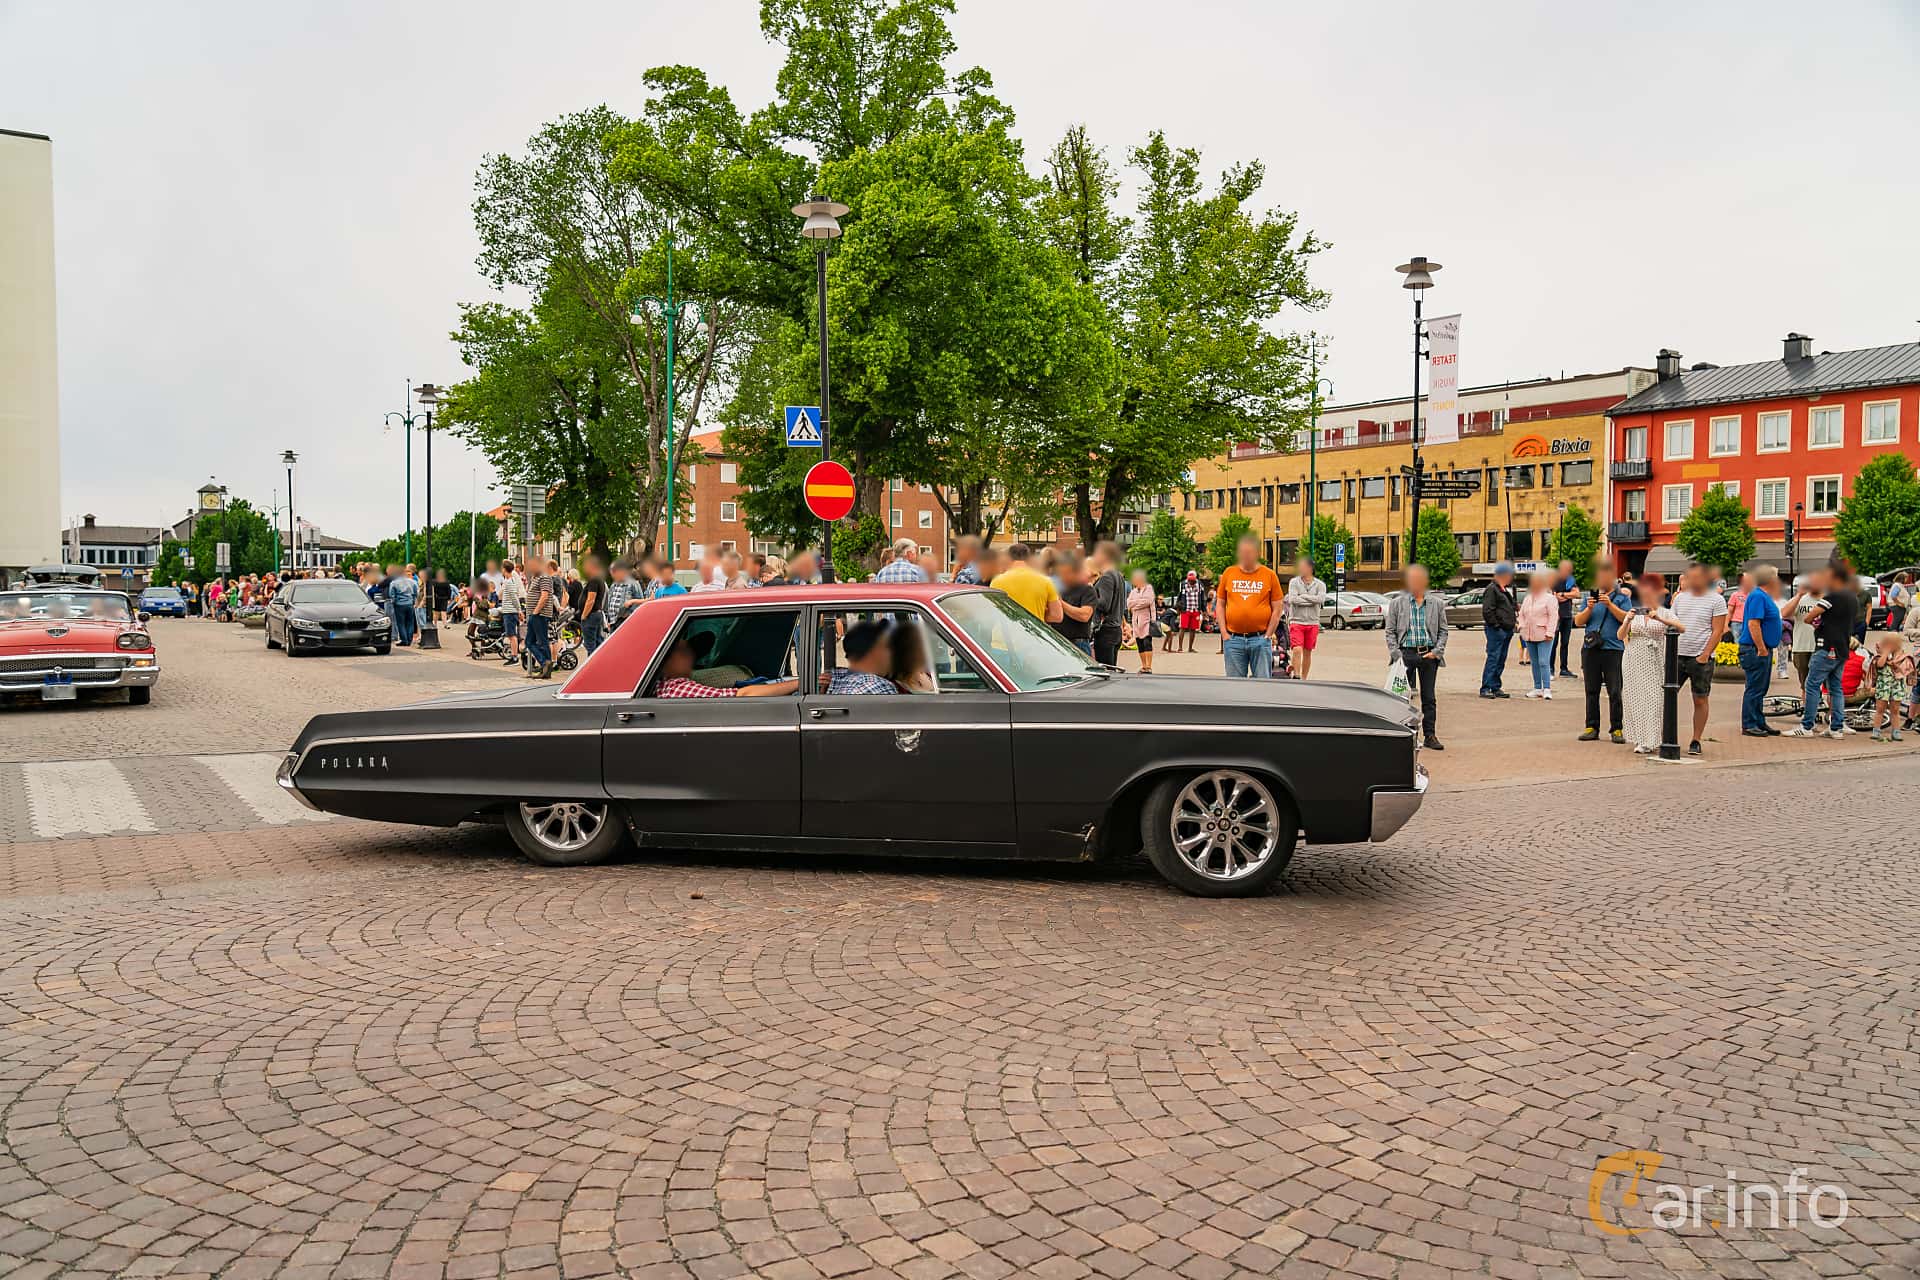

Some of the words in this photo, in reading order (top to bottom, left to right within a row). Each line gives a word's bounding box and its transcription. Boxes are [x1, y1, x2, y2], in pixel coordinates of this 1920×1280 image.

[1551, 436, 1591, 454] Bixia
[1232, 580, 1263, 590] TEXAS
[321, 756, 389, 770] POLARA
